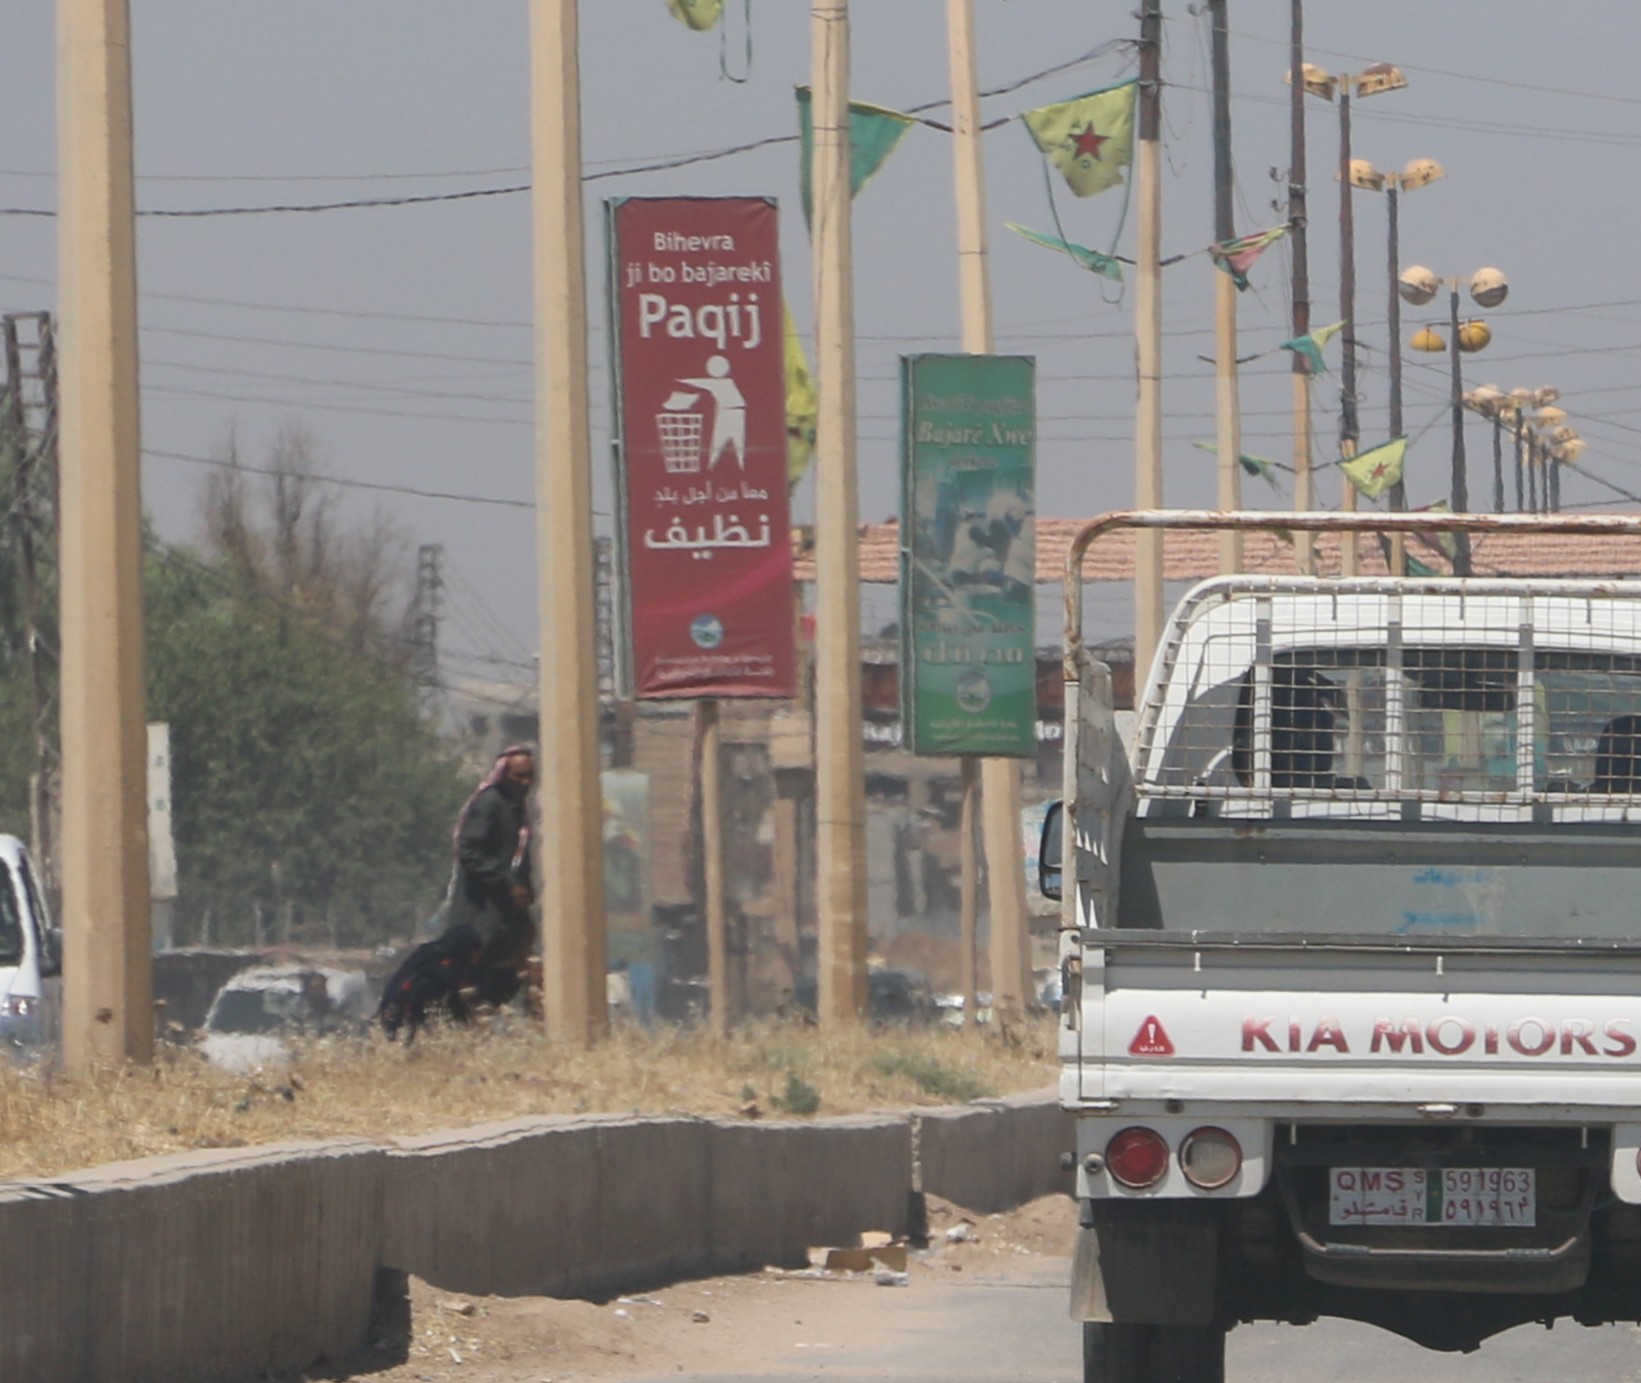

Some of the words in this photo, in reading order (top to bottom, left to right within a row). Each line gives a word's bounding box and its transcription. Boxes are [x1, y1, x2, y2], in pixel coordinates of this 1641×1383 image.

[654, 232, 735, 251] Bihevra
[626, 262, 642, 288] ji
[648, 261, 676, 283] bo
[681, 261, 772, 287] bajarekî
[639, 293, 761, 350] Paqij
[715, 485, 739, 503] من
[644, 514, 770, 560] نظيف
[1240, 1013, 1351, 1054] KIA
[1369, 1014, 1638, 1058] MOTORS
[1337, 1171, 1404, 1192] QMS
[1445, 1170, 1530, 1193] 591963
